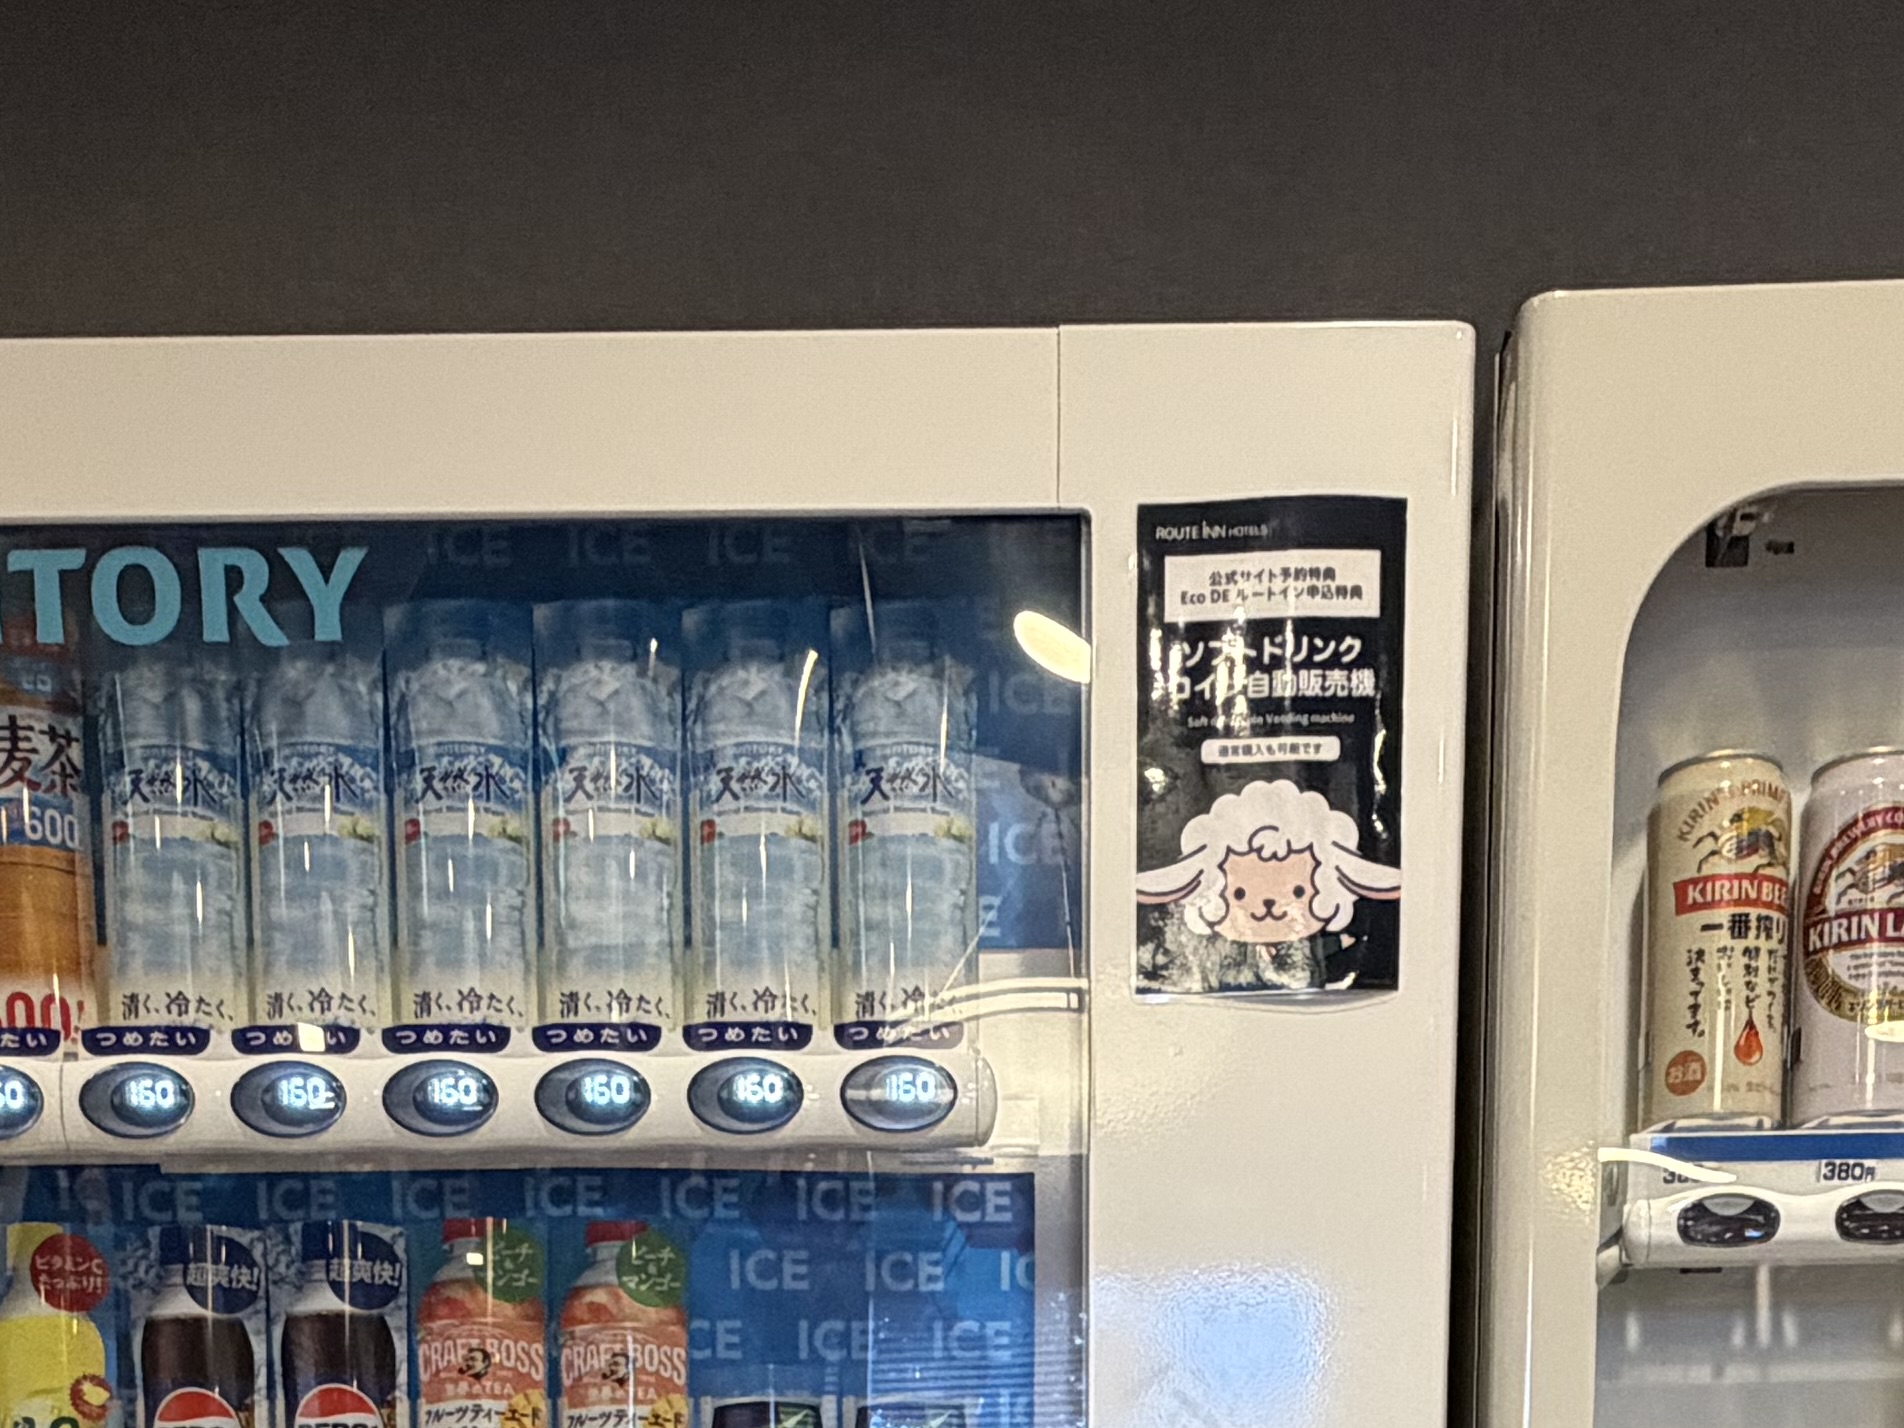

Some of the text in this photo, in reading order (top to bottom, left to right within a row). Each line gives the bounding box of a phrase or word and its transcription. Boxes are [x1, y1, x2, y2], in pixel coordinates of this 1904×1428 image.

[1156, 524, 1198, 540] ROUTE
[1180, 589, 1207, 605] Eco
[1211, 588, 1231, 604] DE
[716, 766, 805, 801] 天然水
[1687, 878, 1788, 905] KIRIN BEE
[1808, 913, 1880, 952] KIRIN
[1822, 1161, 1876, 1182] 380円
[933, 1180, 1013, 1222] ICE
[490, 1337, 544, 1382] BOSS
